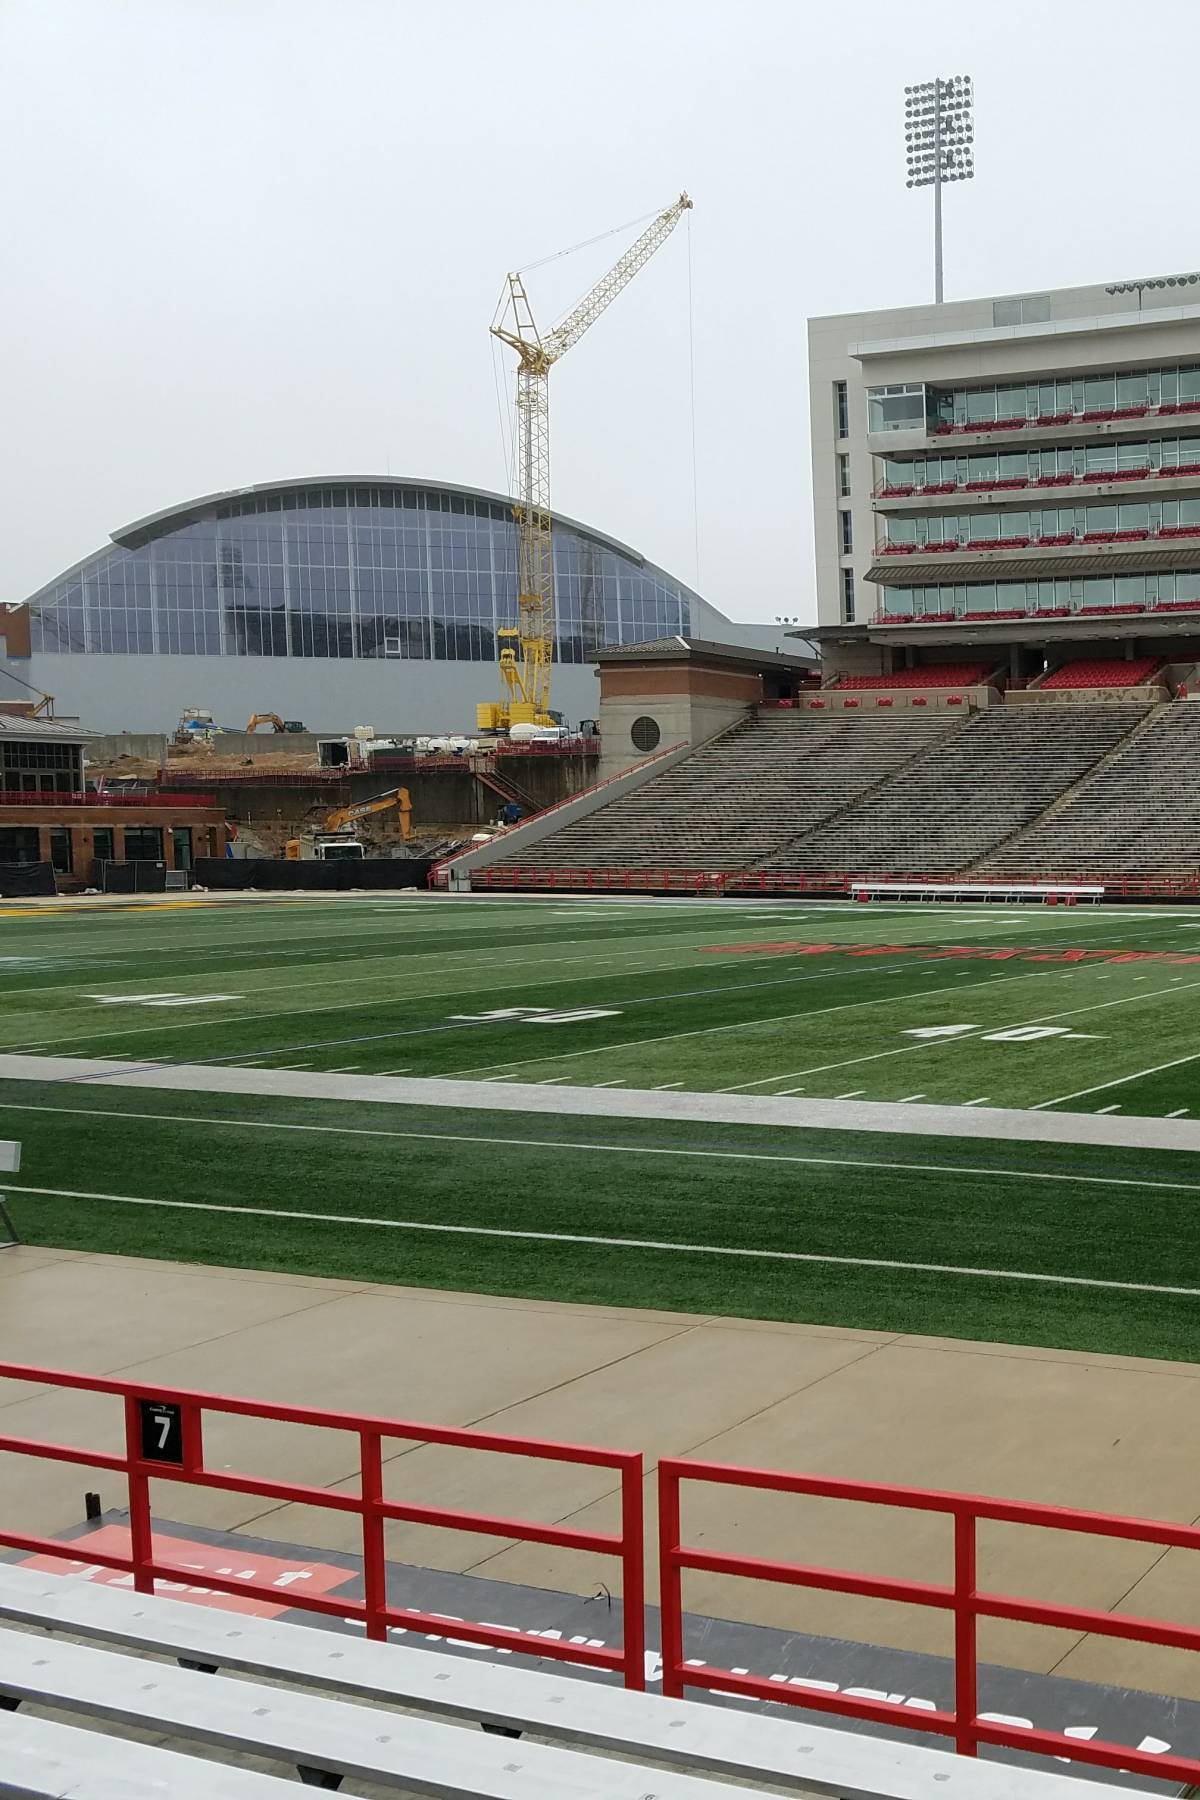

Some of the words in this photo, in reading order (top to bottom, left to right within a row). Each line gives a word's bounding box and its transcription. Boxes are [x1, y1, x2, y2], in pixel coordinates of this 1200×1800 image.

[347, 806, 372, 817] CASE
[448, 1007, 625, 1024] 50
[899, 1023, 1073, 1041] 40
[154, 1415, 171, 1449] 7
